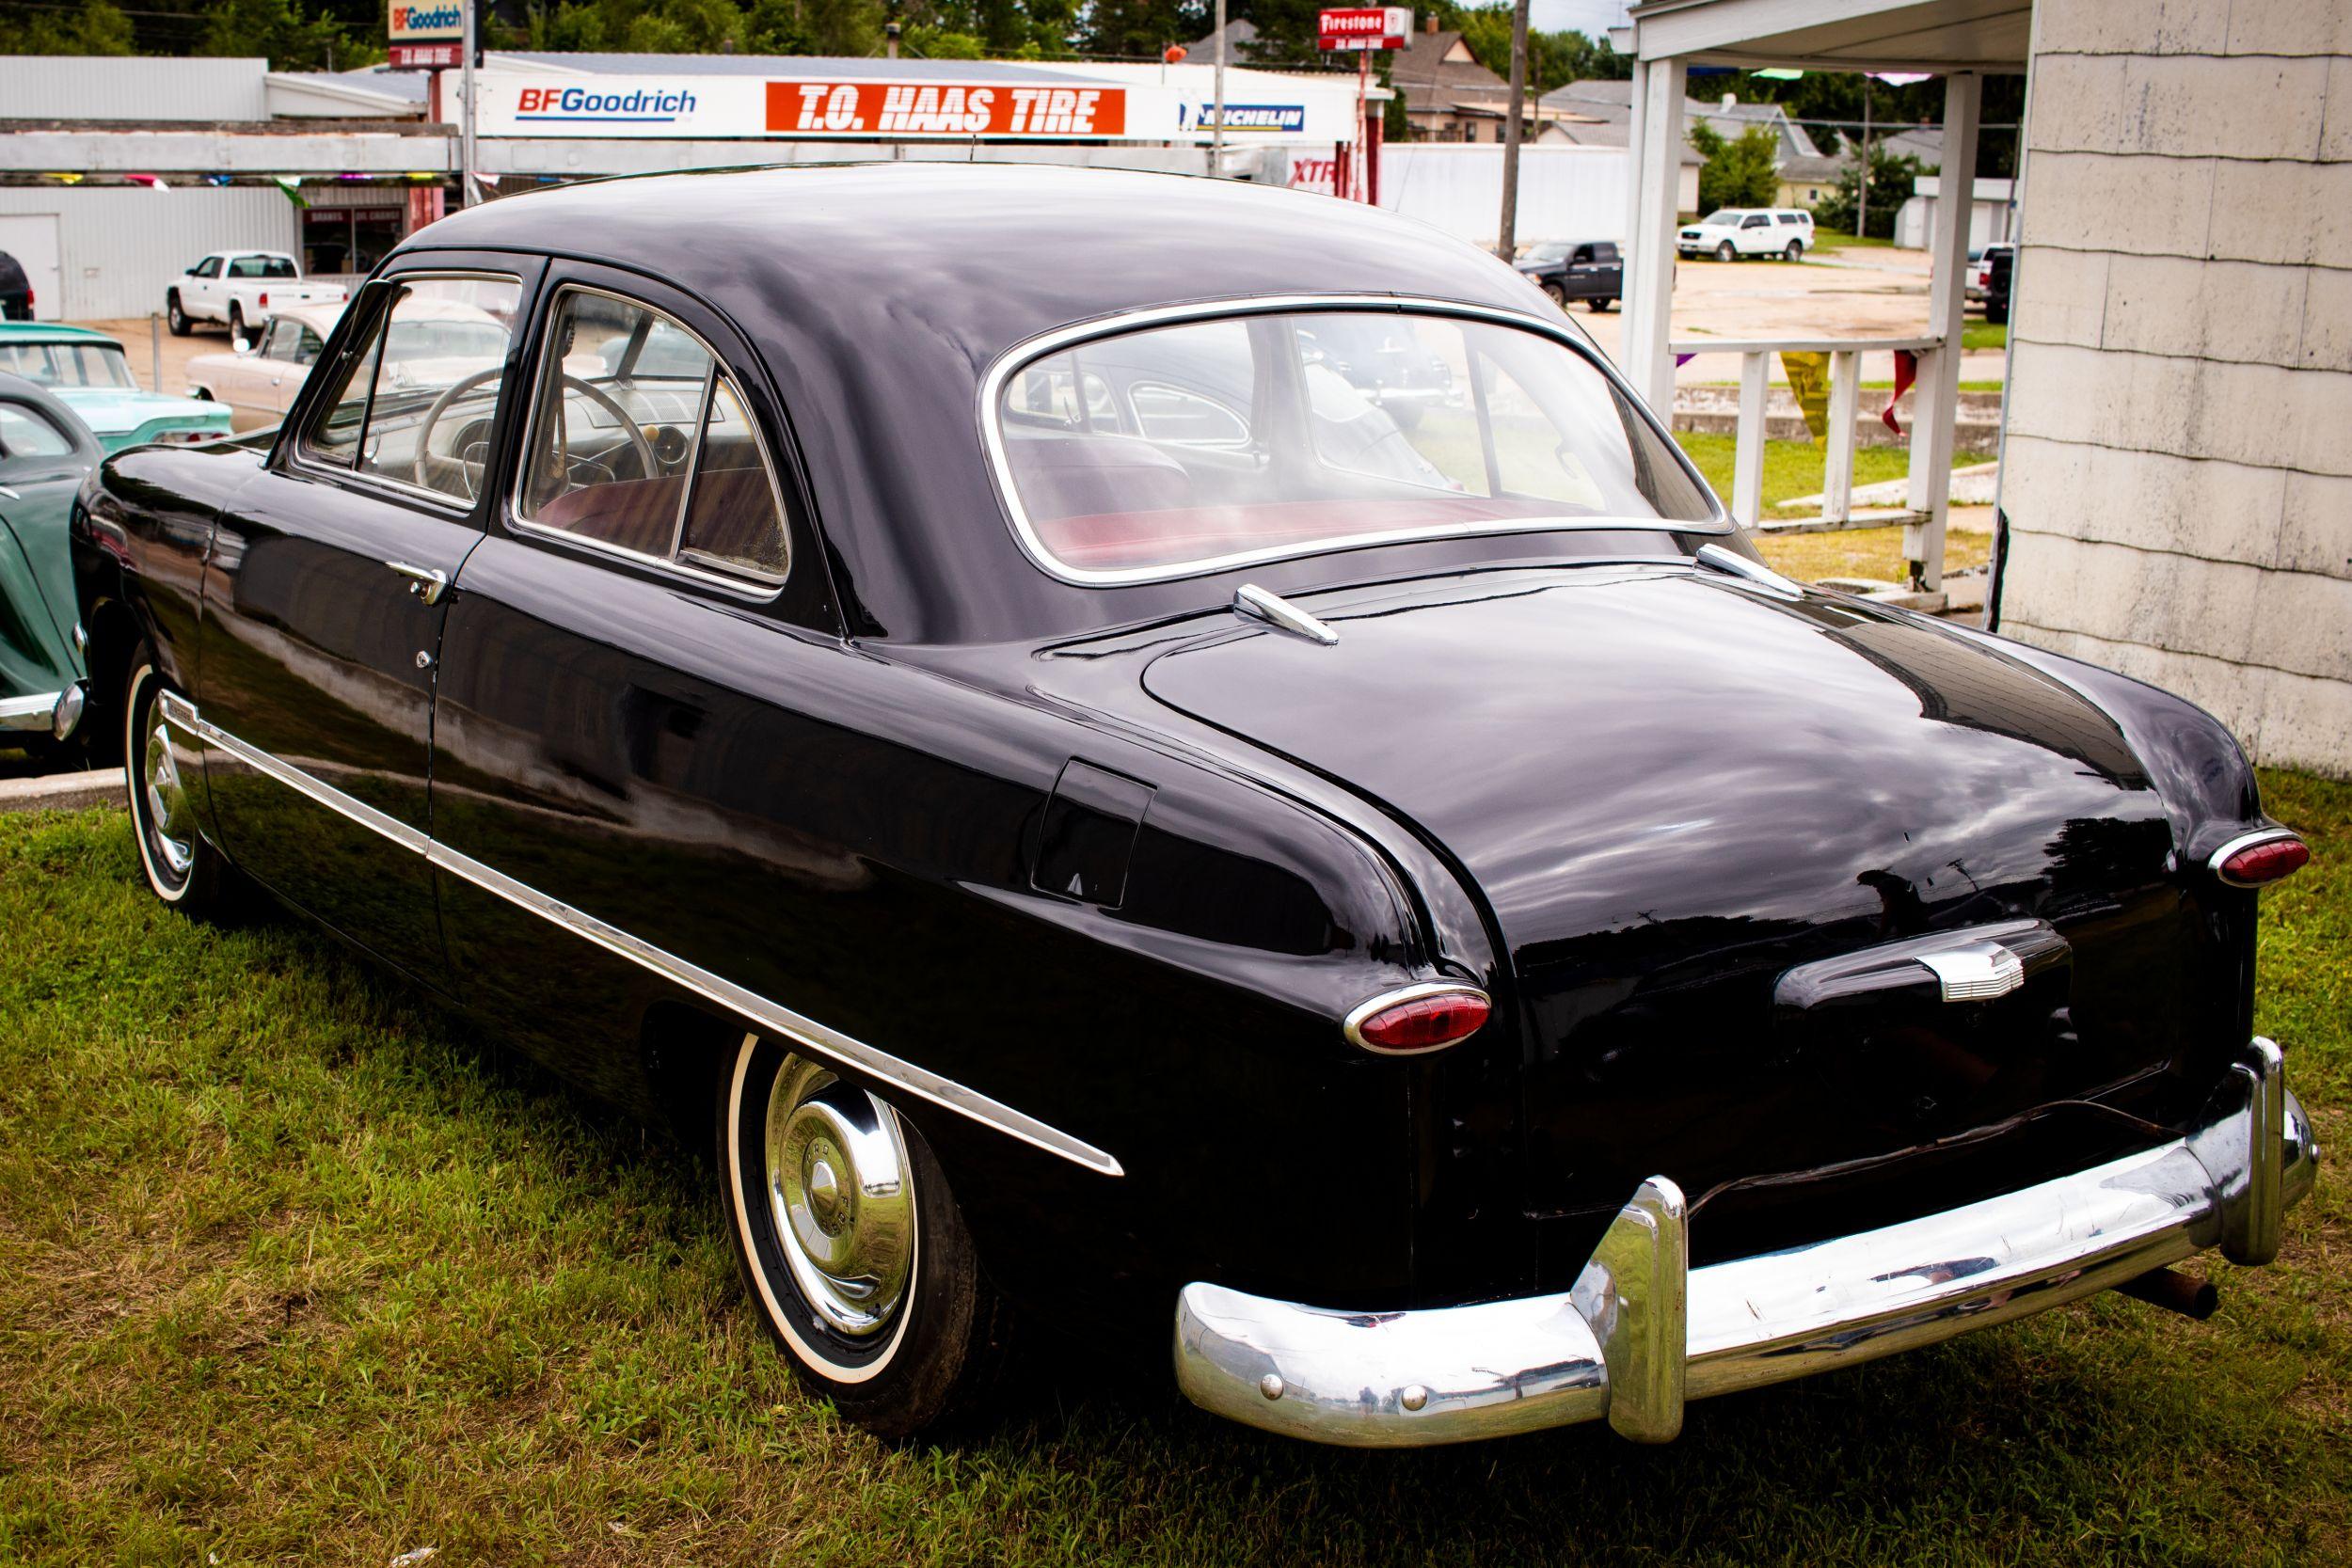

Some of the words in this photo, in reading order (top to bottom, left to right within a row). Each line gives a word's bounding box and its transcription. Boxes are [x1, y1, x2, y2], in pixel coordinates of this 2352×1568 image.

[393, 4, 461, 31] BFGoodrich
[1321, 14, 1382, 34] Firestone
[518, 88, 696, 112] BFGoodrich
[797, 84, 864, 130] T.O.
[878, 85, 994, 132] HAAS
[1009, 88, 1101, 134] TIRE
